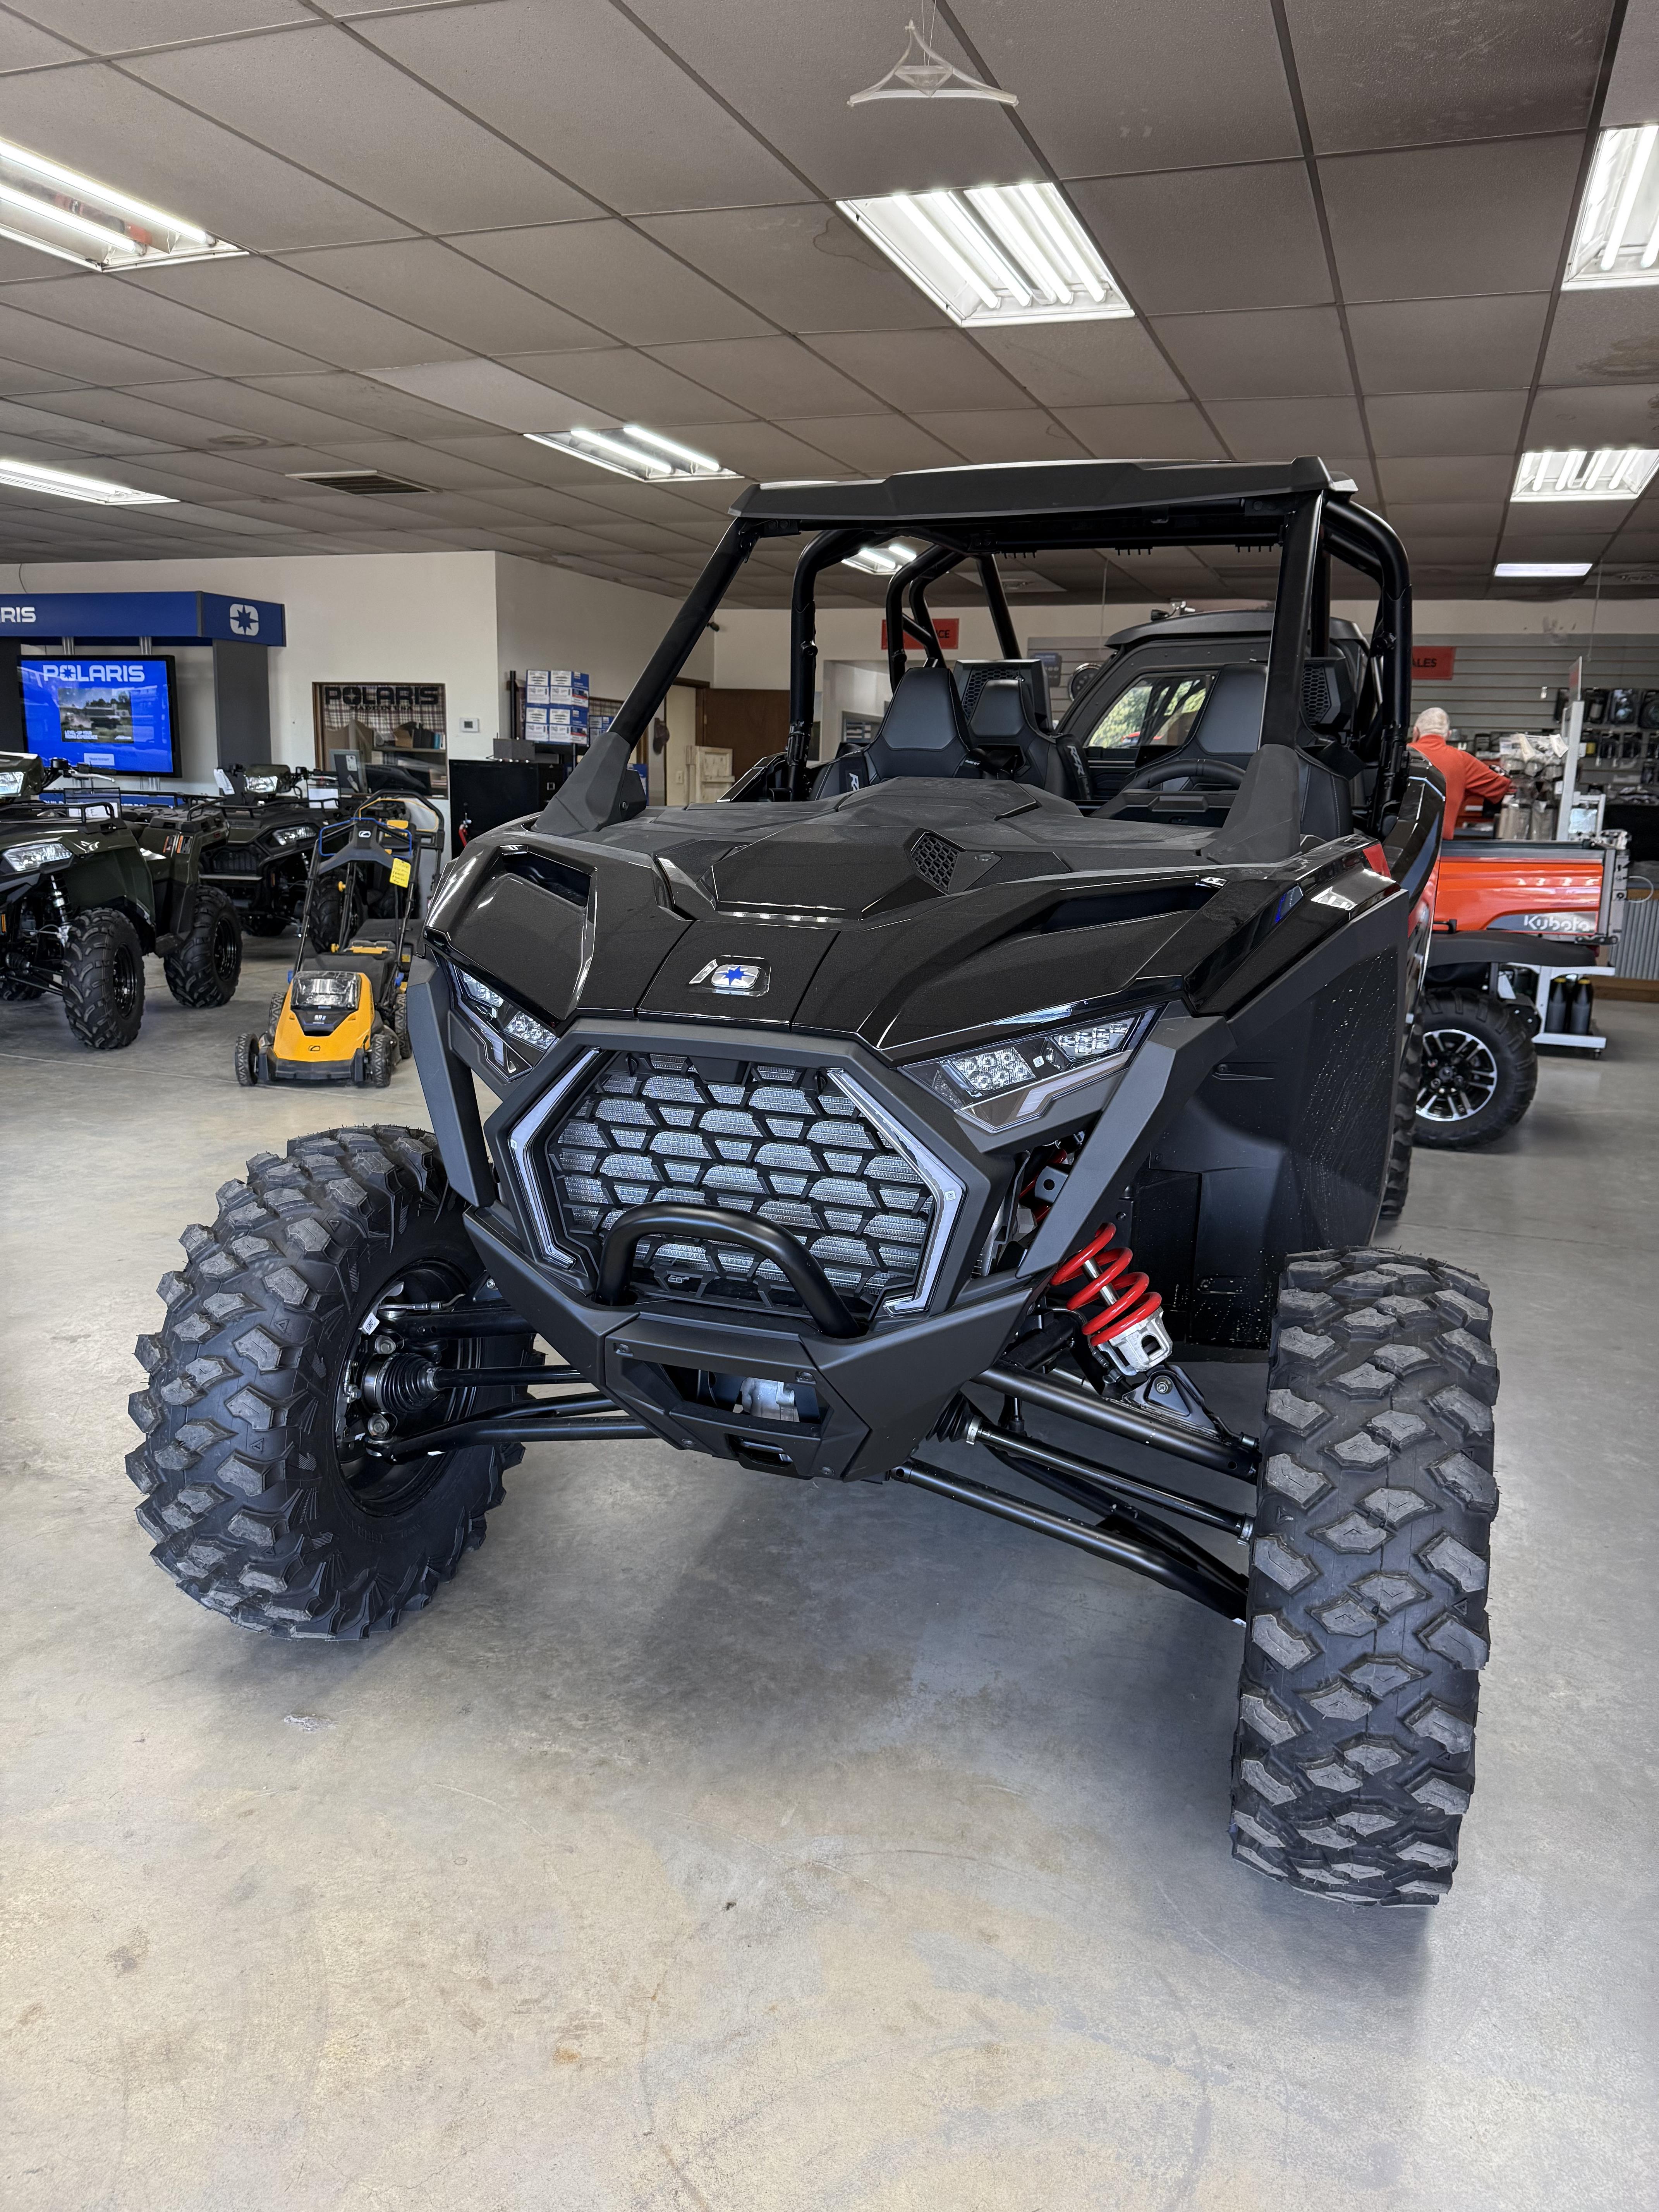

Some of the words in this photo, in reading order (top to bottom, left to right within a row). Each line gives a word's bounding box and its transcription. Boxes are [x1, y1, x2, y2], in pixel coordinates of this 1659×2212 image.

[0, 607, 36, 622] RIS
[43, 665, 145, 682] POLARIS
[325, 686, 438, 705] POLARIS
[1524, 915, 1590, 932] Kubota
